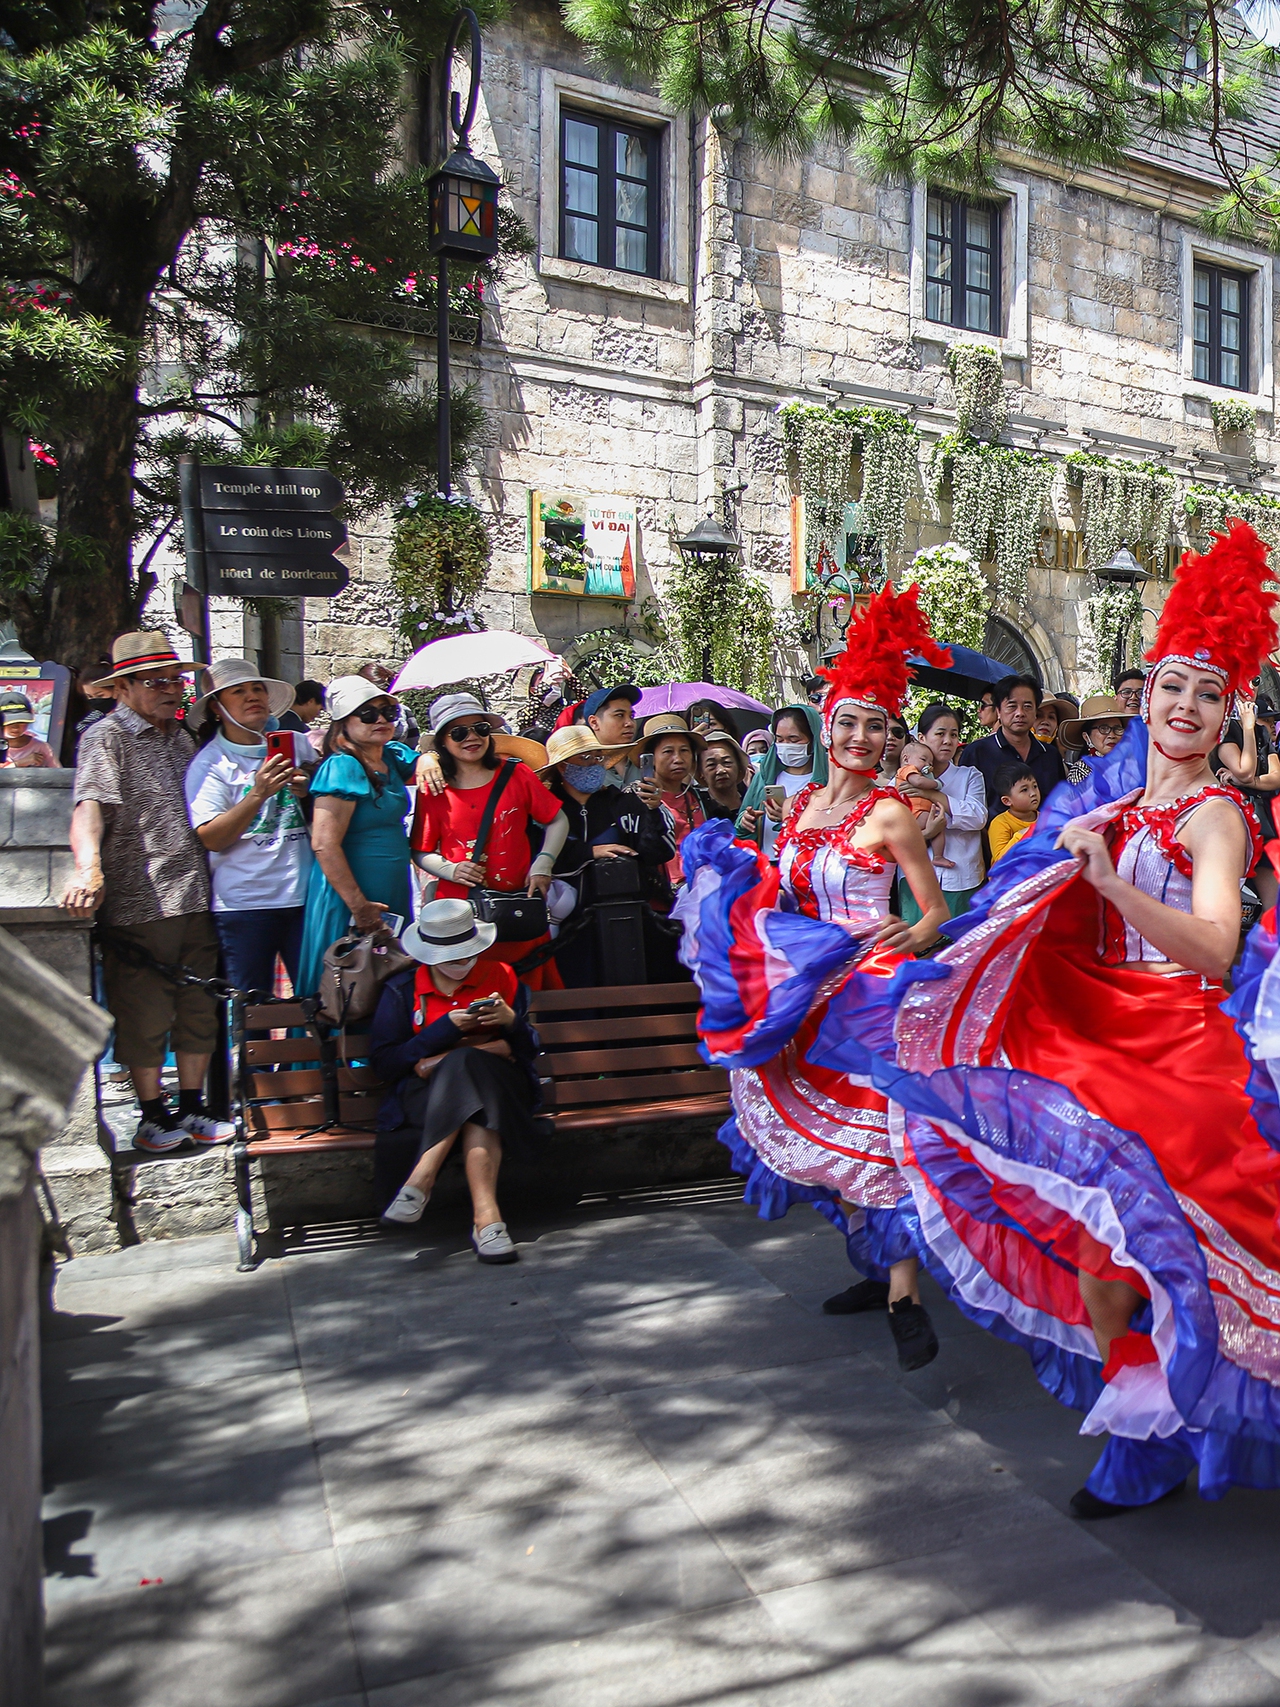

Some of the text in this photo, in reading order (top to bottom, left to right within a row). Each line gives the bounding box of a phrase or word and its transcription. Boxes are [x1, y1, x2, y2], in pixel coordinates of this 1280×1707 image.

[213, 482, 321, 498] Temple & Hill top
[220, 525, 332, 540] Le coin des Lions
[220, 567, 338, 580] Hôtel de Bordeaux
[604, 563, 630, 572] COLLINS
